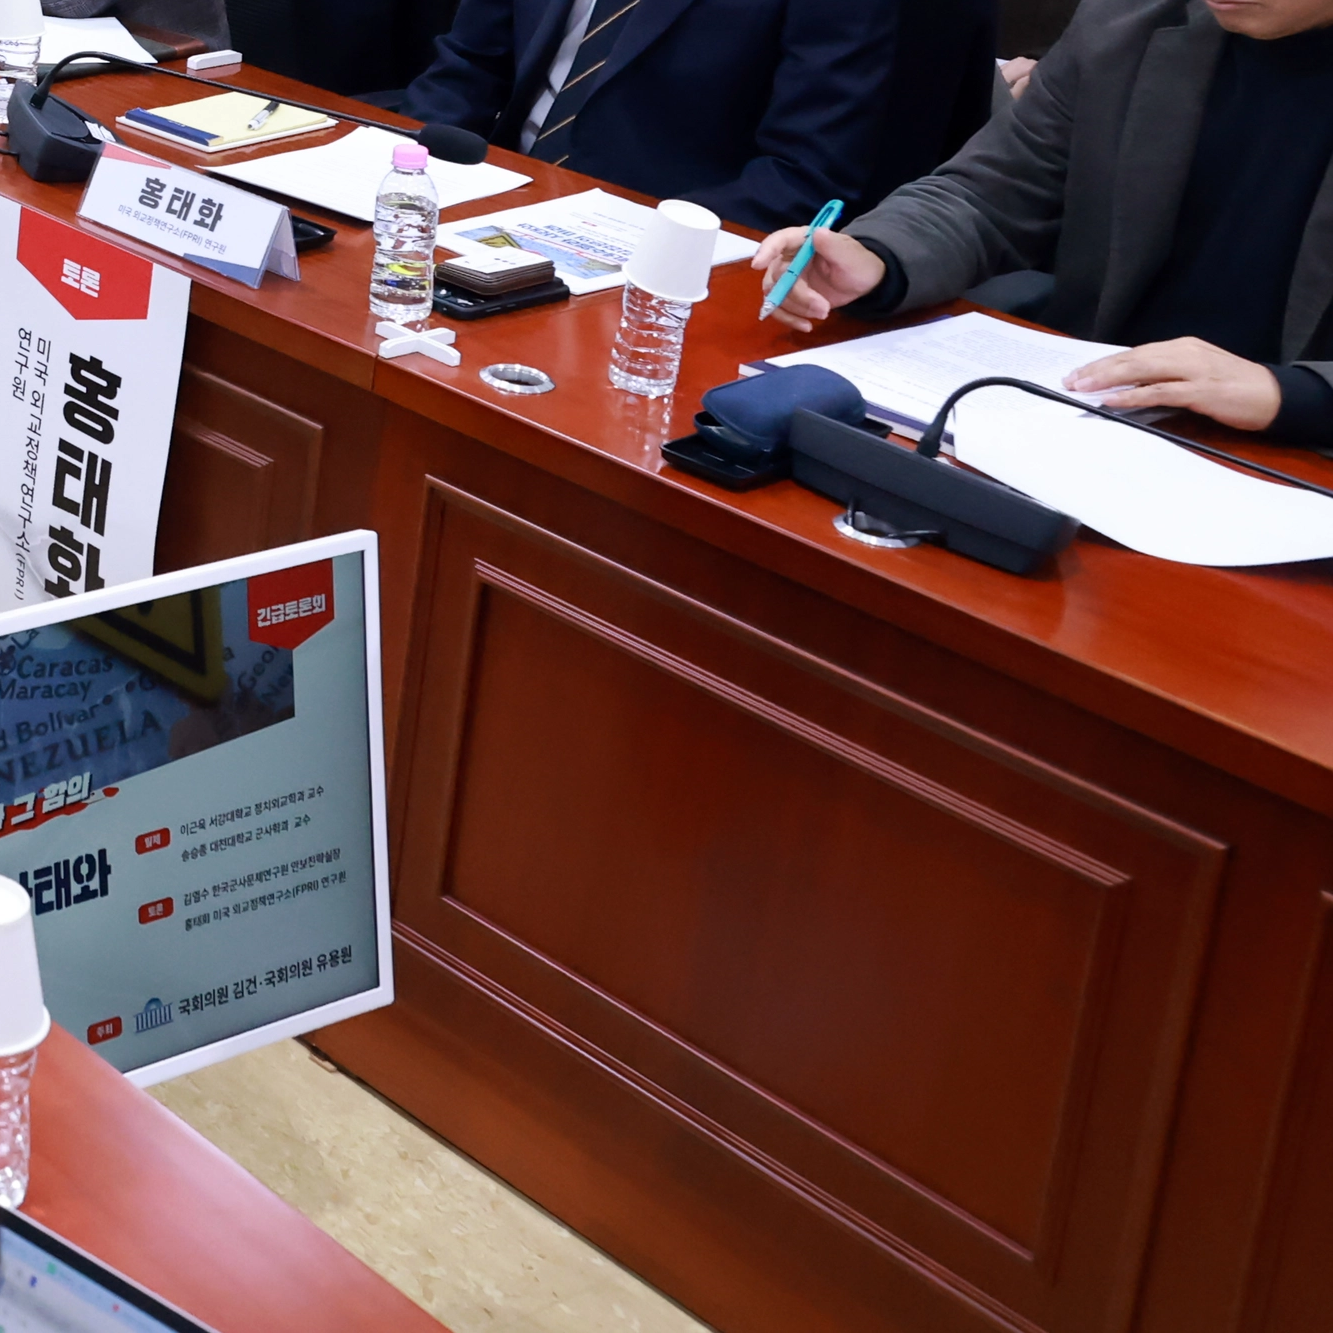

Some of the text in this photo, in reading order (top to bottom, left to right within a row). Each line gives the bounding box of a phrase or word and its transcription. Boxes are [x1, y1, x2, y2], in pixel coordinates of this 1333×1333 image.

[138, 177, 225, 233] 홍태화
[118, 204, 227, 255] 미국 외교정책연구소(FPRI) 연구원
[61, 258, 101, 298] 토론
[12, 326, 32, 401] 연구원
[33, 336, 51, 387] 미국
[44, 352, 122, 600] 홍태화
[257, 593, 326, 628] 긴급토론회
[16, 655, 114, 679] Caracas
[16, 703, 101, 744] Bolívar
[11, 792, 36, 826] 그
[42, 771, 92, 814] 함의
[209, 806, 252, 828] 서강대학교
[307, 785, 324, 800] 교수
[294, 814, 311, 829] 교수
[213, 906, 230, 921] 미국
[178, 985, 229, 1016] 국회의원
[316, 944, 353, 972] 유용원
